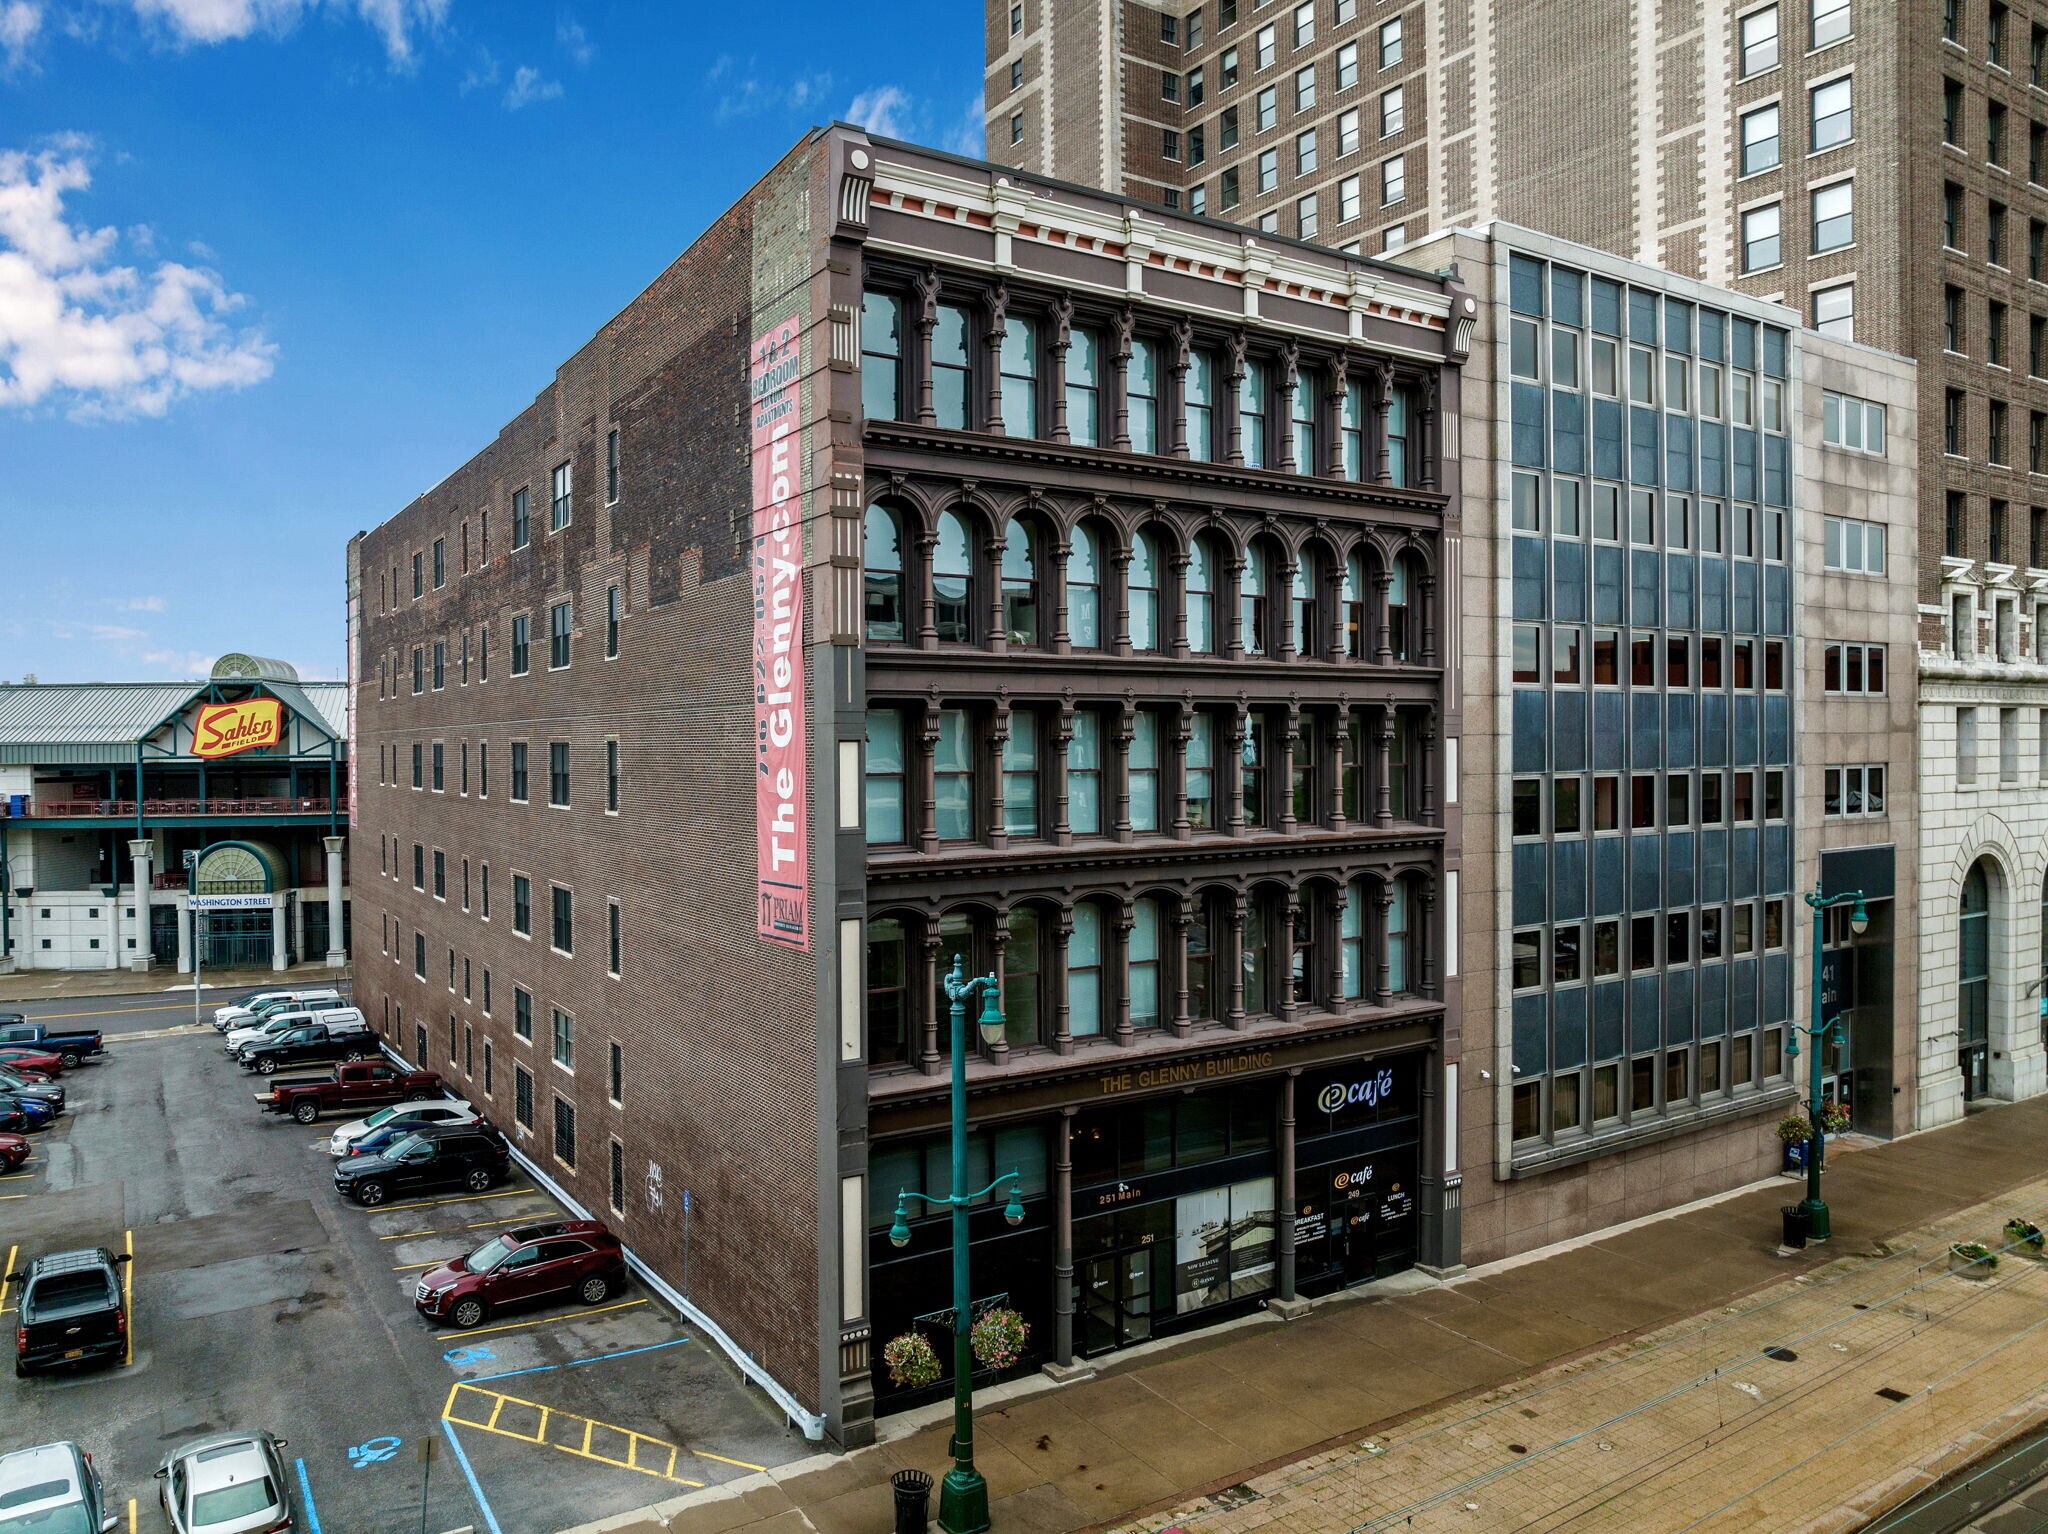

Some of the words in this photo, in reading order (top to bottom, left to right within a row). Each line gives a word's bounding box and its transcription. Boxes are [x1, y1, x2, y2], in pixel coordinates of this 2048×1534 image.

[782, 328, 791, 357] 2
[752, 356, 799, 399] BEDROOM
[767, 422, 796, 748] Glenny.com
[202, 707, 274, 750] Sahlen
[232, 736, 258, 747] FIELD
[772, 767, 796, 872] The
[189, 898, 242, 907] WASHINGTON
[244, 897, 272, 906] STREET
[773, 896, 803, 924] PRIAM
[1822, 964, 1834, 981] 41
[1821, 988, 1837, 1004] ain
[1101, 1074, 1131, 1093] THE
[1138, 1063, 1200, 1088] GLENNY
[1206, 1052, 1273, 1076] BUILDING
[1099, 1195, 1116, 1205] 251
[1118, 1188, 1141, 1201] Main
[1348, 1189, 1360, 1199] 249
[1387, 1192, 1405, 1202] LUNCH
[1141, 1233, 1154, 1244] 251
